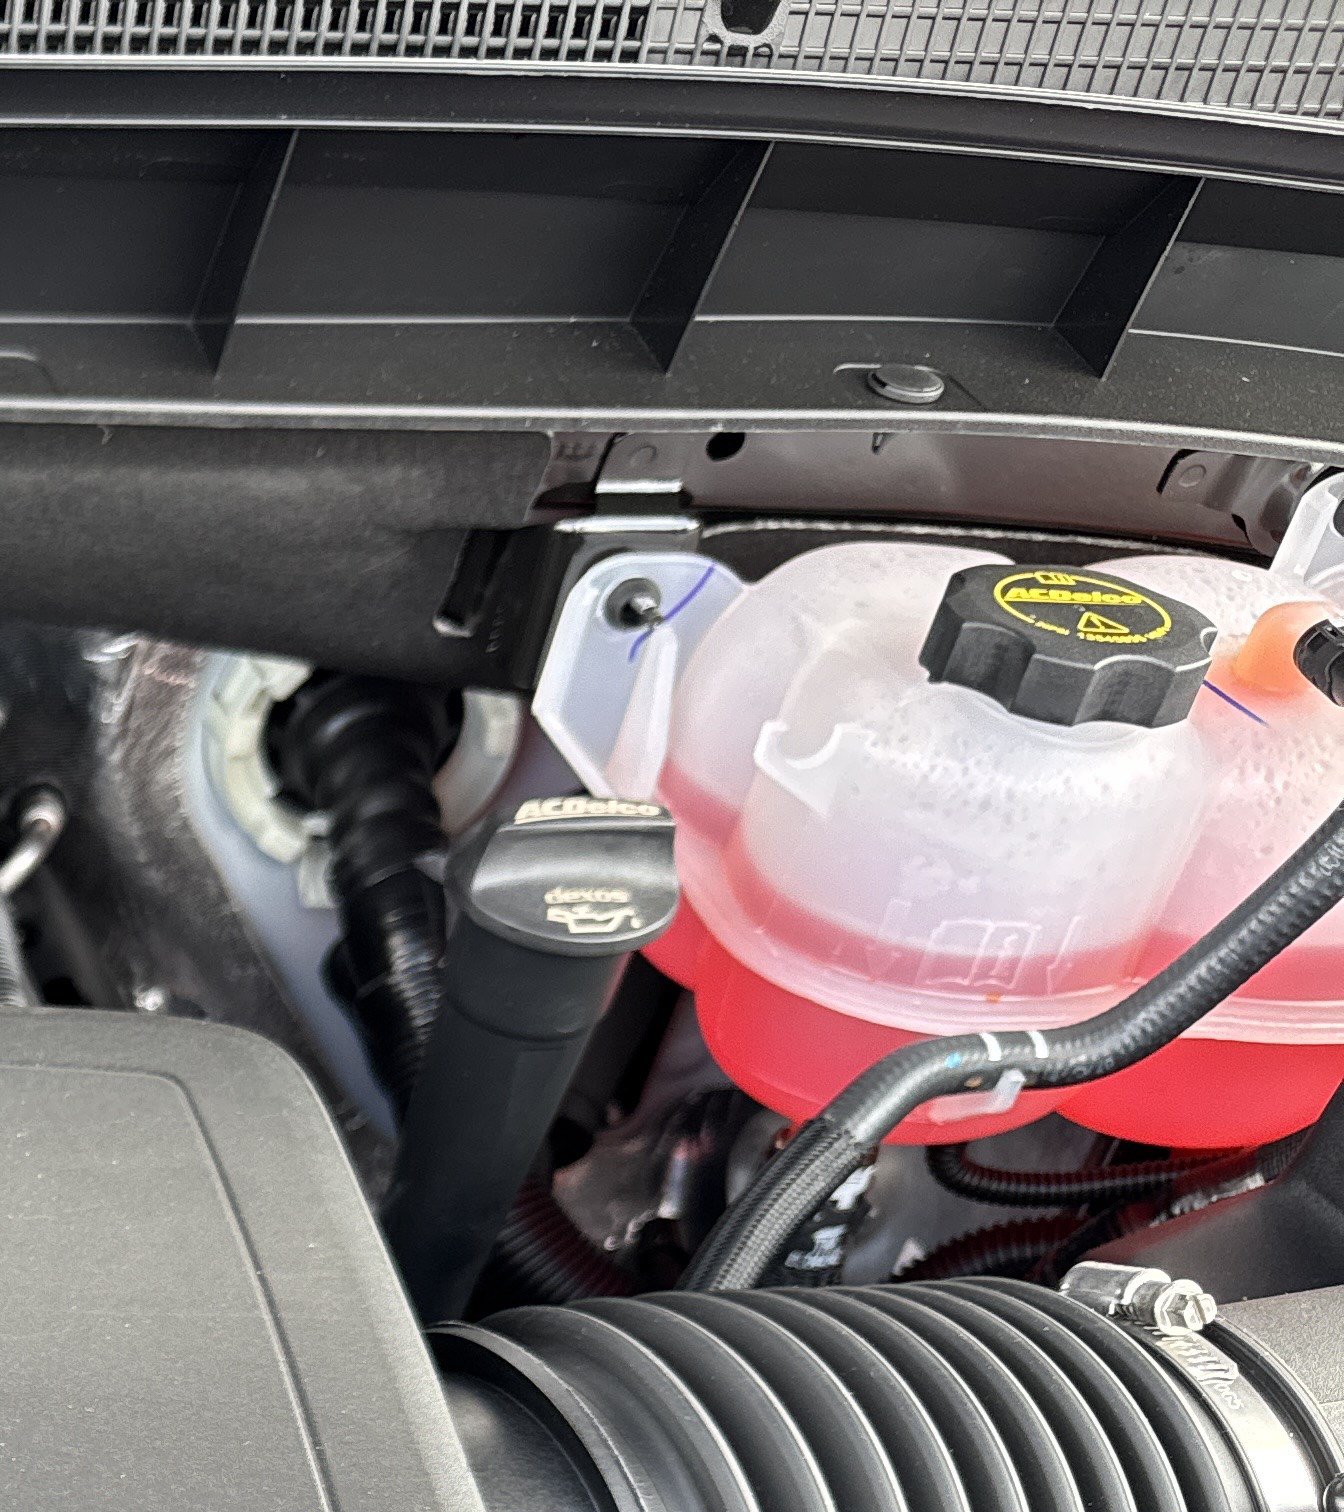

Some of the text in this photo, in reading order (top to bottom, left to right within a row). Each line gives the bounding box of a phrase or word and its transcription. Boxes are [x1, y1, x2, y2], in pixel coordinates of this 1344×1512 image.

[1004, 587, 1143, 604] ACDelco
[514, 797, 661, 824] ACDelco
[544, 887, 630, 904] dexos
